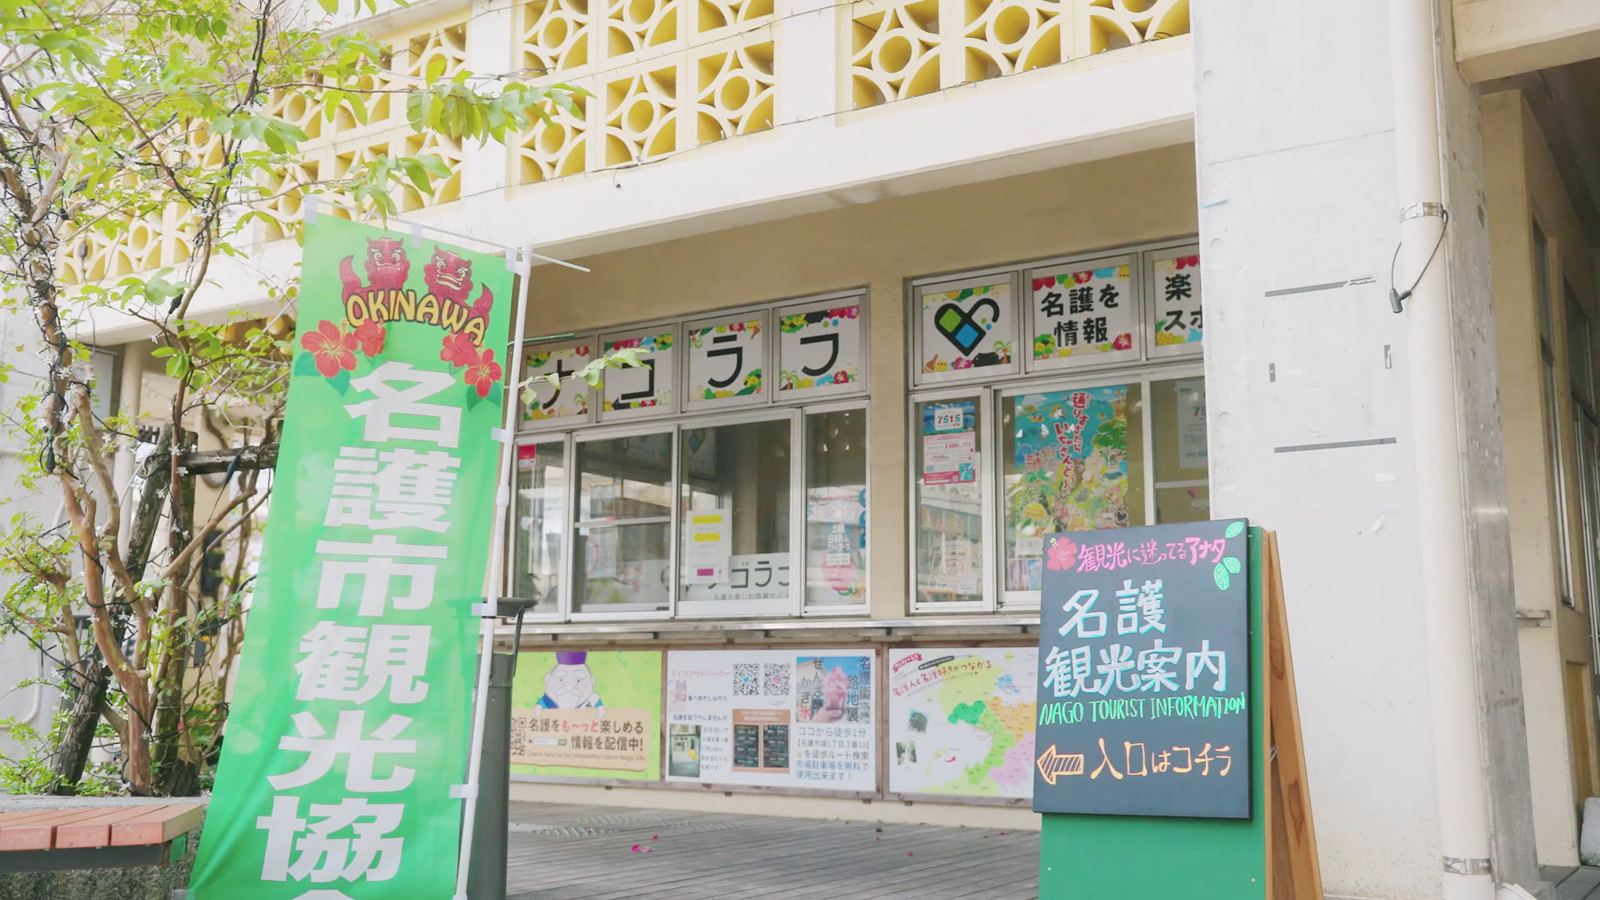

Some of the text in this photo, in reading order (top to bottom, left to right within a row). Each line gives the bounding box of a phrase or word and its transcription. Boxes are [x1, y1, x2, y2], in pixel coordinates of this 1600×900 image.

[1041, 274, 1192, 317] 名護を 楽
[346, 288, 486, 347] OKINAWA
[1054, 317, 1108, 347] 情報
[1077, 537, 1227, 573] 観光に迷ってるアナタ
[1057, 578, 1167, 639] 名護
[255, 361, 464, 900] 名護市観光協
[1042, 638, 1228, 698] 観光案内
[846, 675, 860, 723] 路地裏
[1039, 700, 1084, 726] NAGO
[1089, 697, 1146, 724] TOURIST
[1150, 692, 1246, 720] INFORMATION
[571, 735, 643, 752] 情報を配信中!
[1090, 737, 1232, 780] 入口はコチラ
